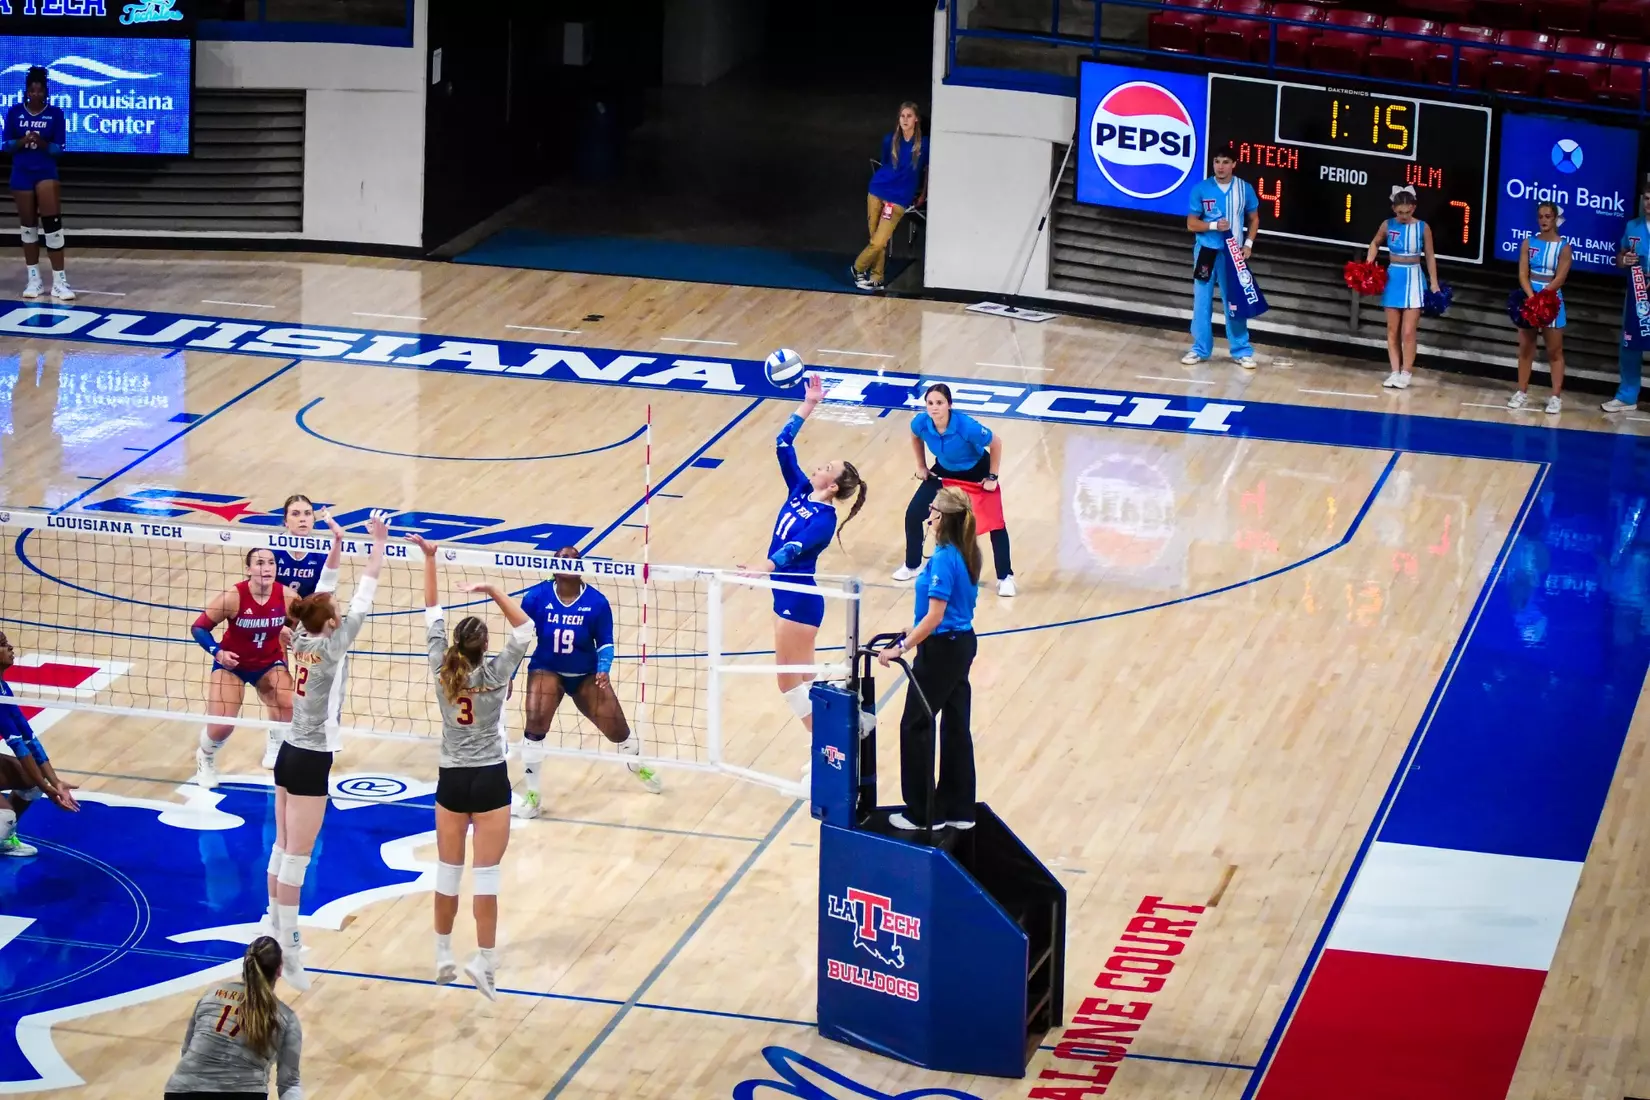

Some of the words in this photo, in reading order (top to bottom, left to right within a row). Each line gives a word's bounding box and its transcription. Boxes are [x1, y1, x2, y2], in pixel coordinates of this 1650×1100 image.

[79, 89, 174, 111] Louisiana
[1327, 87, 1369, 97] DAKTRONICS
[83, 113, 155, 134] Center
[1331, 100, 1408, 150] 1:15
[1096, 122, 1191, 158] PEPSI
[1229, 140, 1299, 169] ATECH
[1320, 165, 1368, 186] PERIOD
[1406, 164, 1442, 188] ULM
[1258, 177, 1282, 218] 4
[1506, 178, 1569, 205] Origin
[1576, 187, 1625, 212] Bank
[1344, 193, 1352, 223] 1
[1450, 200, 1470, 244] 7
[1502, 241, 1518, 252] OF
[1585, 238, 1616, 252] BANK
[804, 369, 1248, 431] TECH
[46, 515, 133, 534] LOUISIANA
[141, 524, 182, 538] TECH
[775, 511, 797, 541] 11
[364, 542, 407, 558] TCH
[278, 567, 290, 577] LA
[292, 568, 314, 578] TECH
[495, 553, 585, 572] LOUISIANA
[593, 562, 636, 576] TECH
[235, 617, 270, 629] LOUISIANA
[547, 612, 559, 624] LA
[562, 615, 584, 626] TECH
[252, 632, 267, 649] 4
[553, 629, 575, 654] 19
[456, 696, 474, 726] 3
[828, 894, 857, 923] LA
[1094, 895, 1207, 994] COURT
[827, 958, 920, 1002] BULLDOGS
